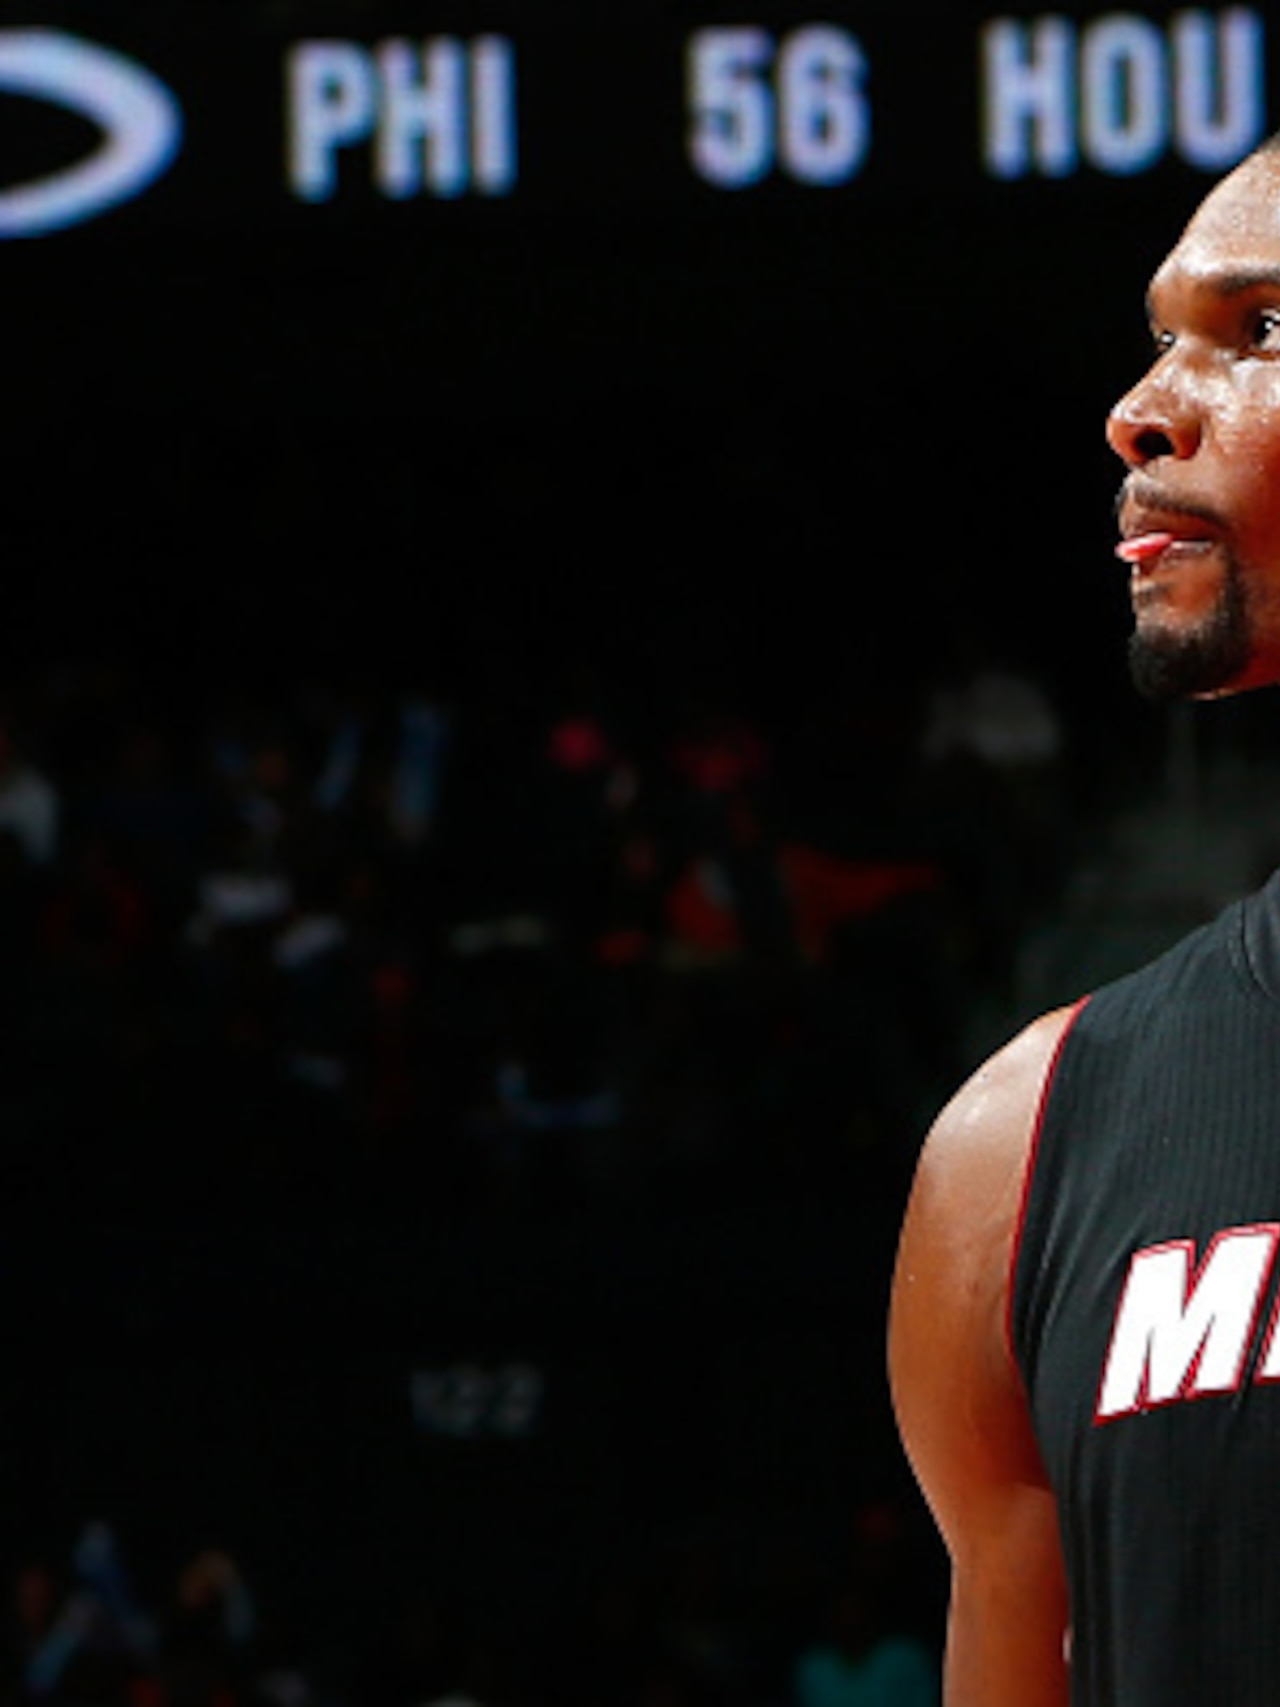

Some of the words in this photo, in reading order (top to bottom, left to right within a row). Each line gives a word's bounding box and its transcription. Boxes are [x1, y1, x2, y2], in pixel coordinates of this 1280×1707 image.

[289, 36, 517, 200] PHI
[690, 25, 871, 188] 56
[984, 9, 1265, 178] HOU
